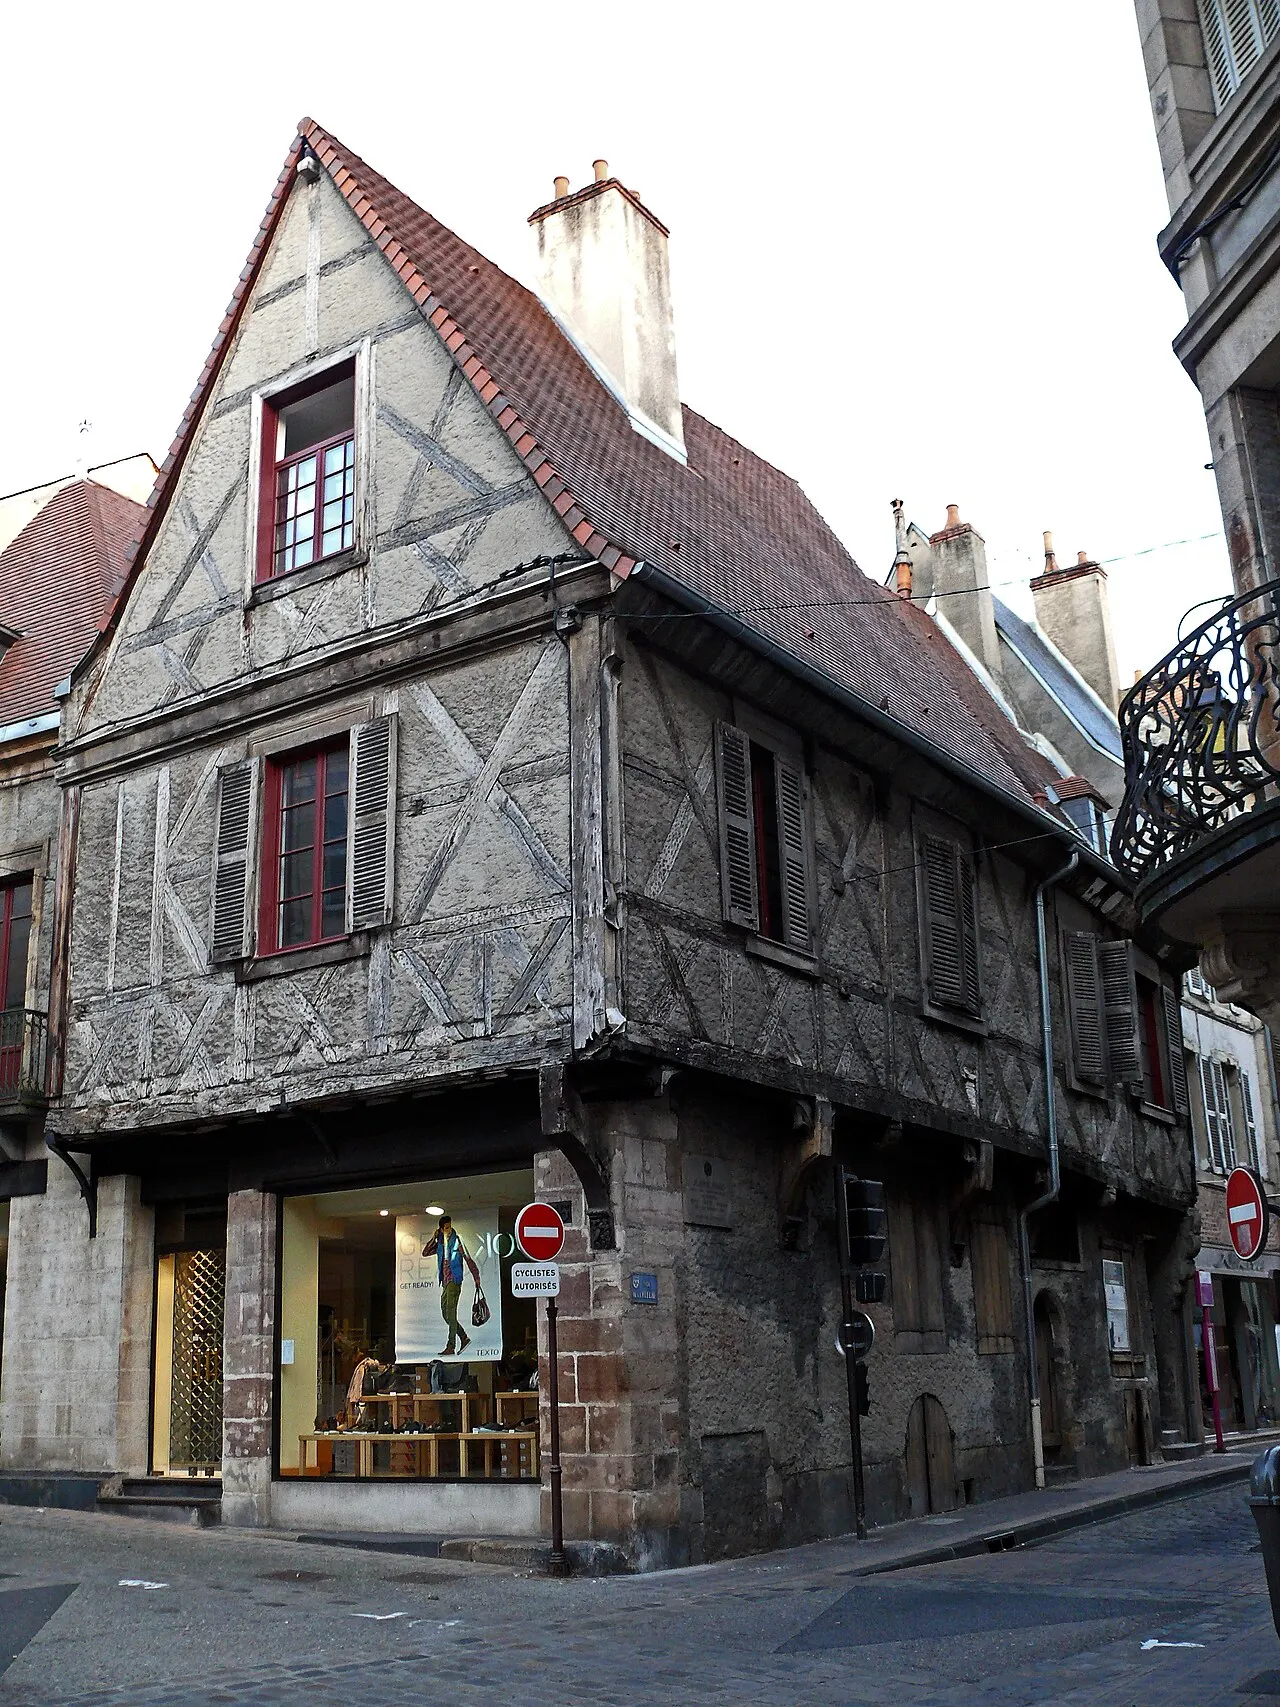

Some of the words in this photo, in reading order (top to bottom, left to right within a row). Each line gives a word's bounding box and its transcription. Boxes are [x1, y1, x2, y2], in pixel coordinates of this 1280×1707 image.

[515, 1269, 556, 1277] CYCLISTES
[412, 1281, 434, 1289] READY!
[514, 1281, 557, 1290] AUTORISÉS
[476, 1349, 499, 1357] TEXTO
